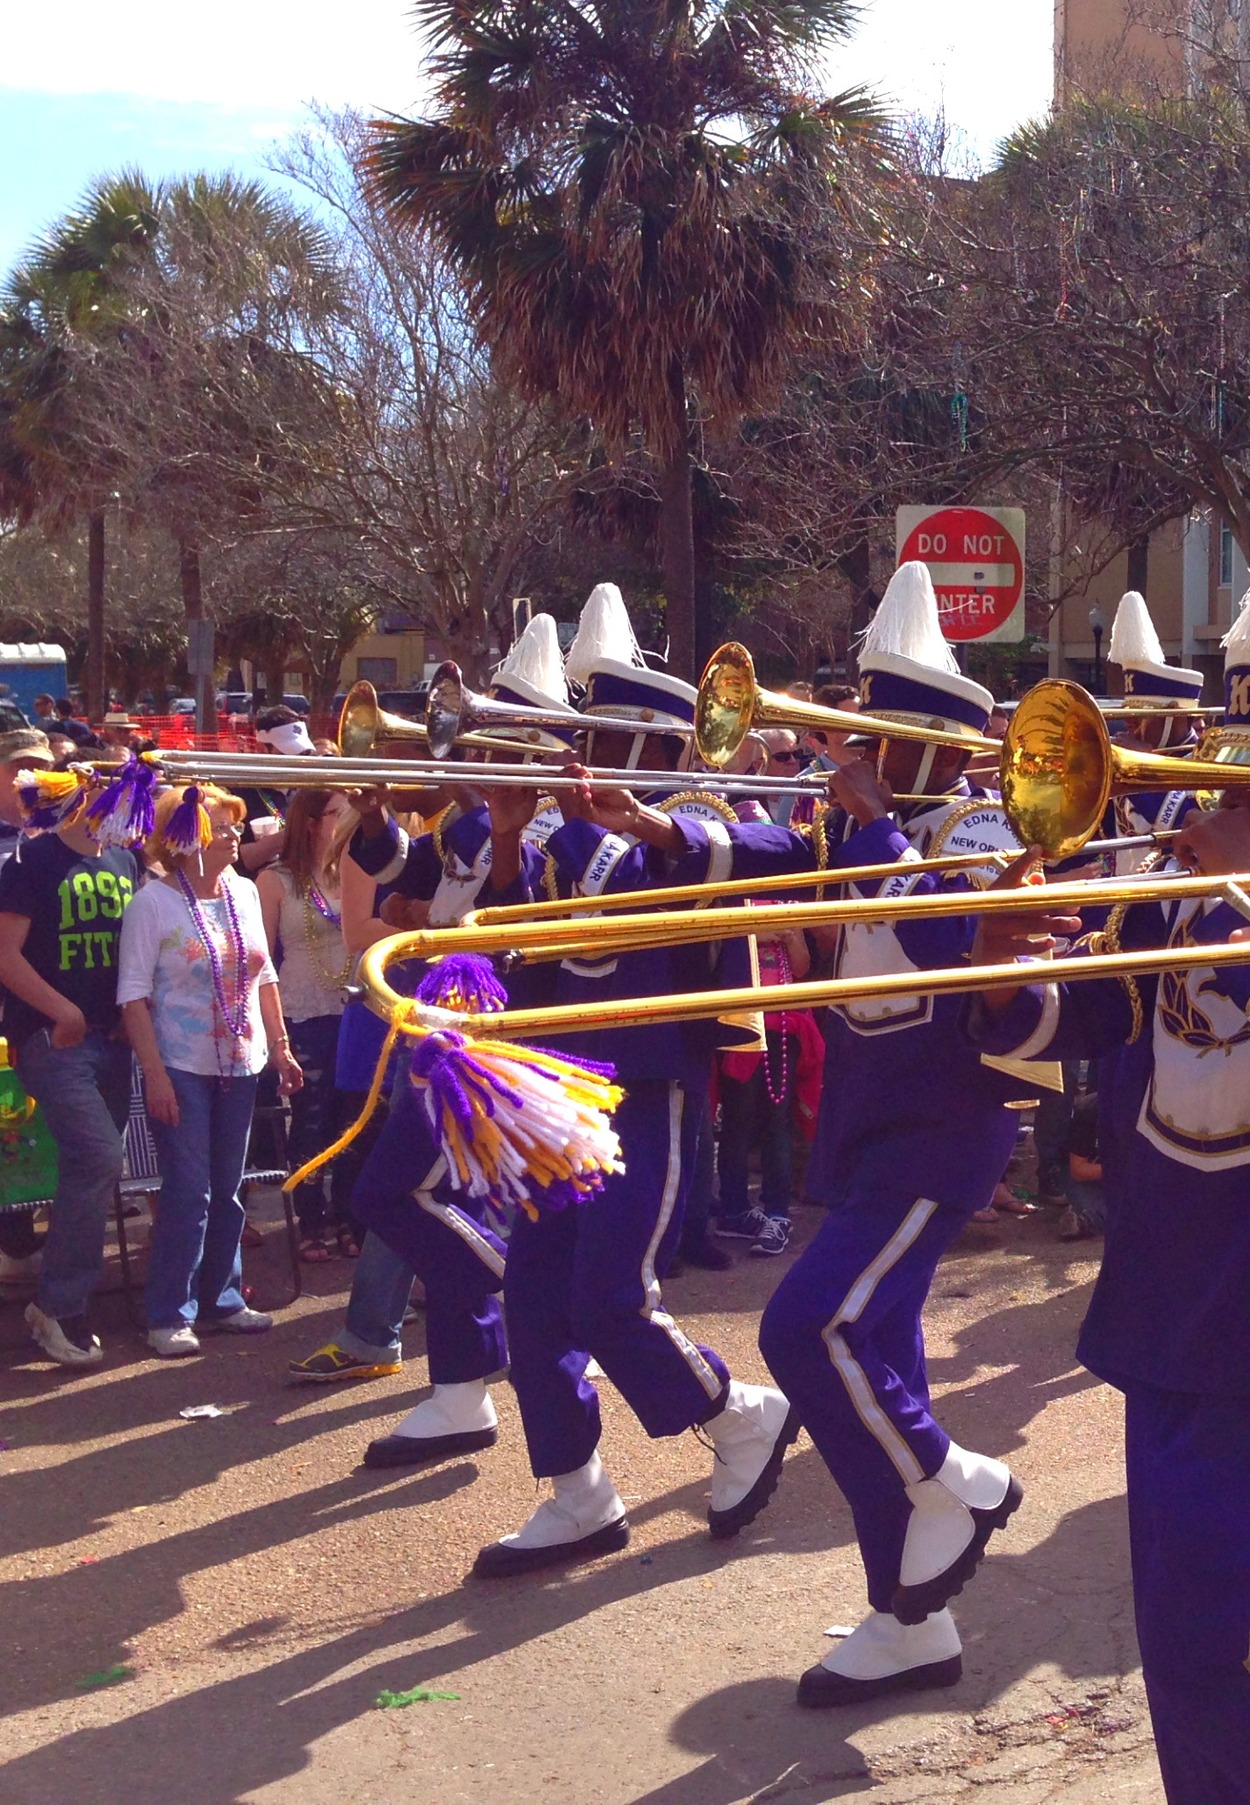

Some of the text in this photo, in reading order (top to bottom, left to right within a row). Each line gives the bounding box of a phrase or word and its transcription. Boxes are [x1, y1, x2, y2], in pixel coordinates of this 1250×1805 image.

[918, 534, 1004, 555] DO NOT
[935, 594, 995, 614] NTER
[679, 805, 708, 816] EDNA
[963, 813, 998, 829] EDNA
[951, 836, 977, 849] NEW
[589, 852, 612, 882] KARR
